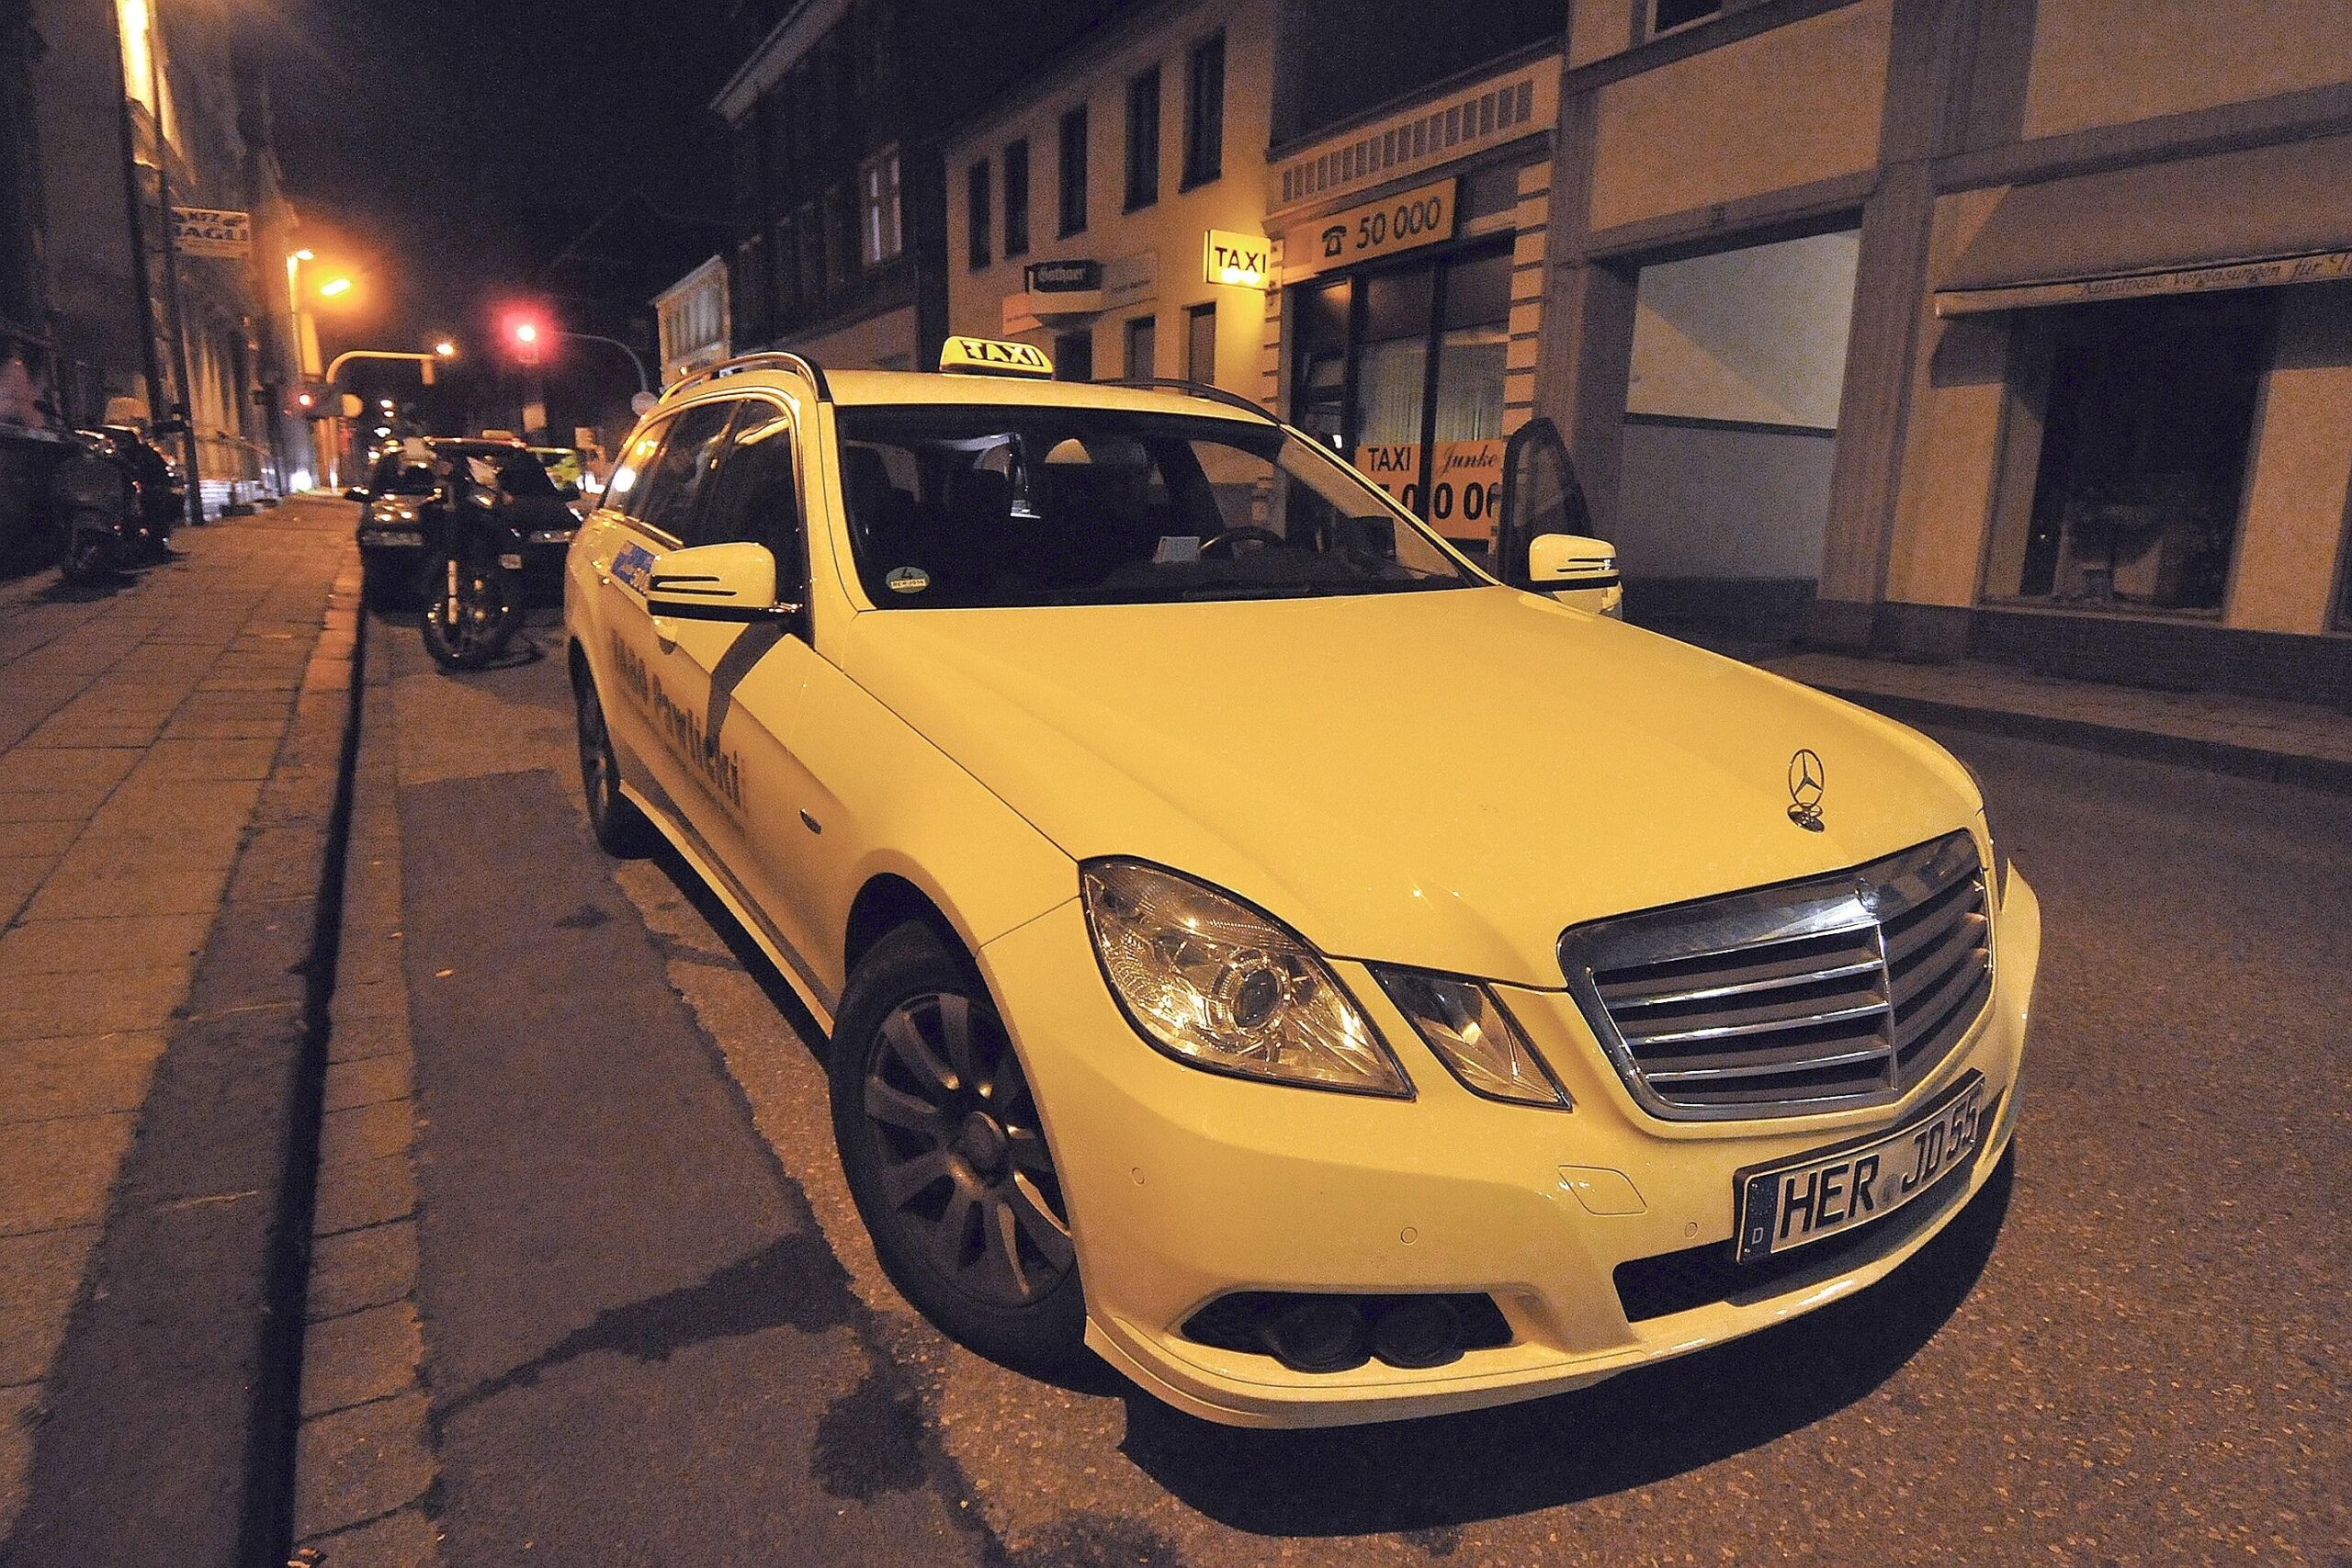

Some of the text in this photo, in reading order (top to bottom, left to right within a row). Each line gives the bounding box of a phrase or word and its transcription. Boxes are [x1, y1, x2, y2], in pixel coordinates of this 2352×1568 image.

[1356, 195, 1442, 250] 50 000
[1215, 246, 1267, 274] TAXI
[960, 340, 1045, 367] TAXI
[1368, 446, 1411, 471] TAXI
[1779, 1154, 1880, 1238] HER
[1751, 1227, 1764, 1246] D
